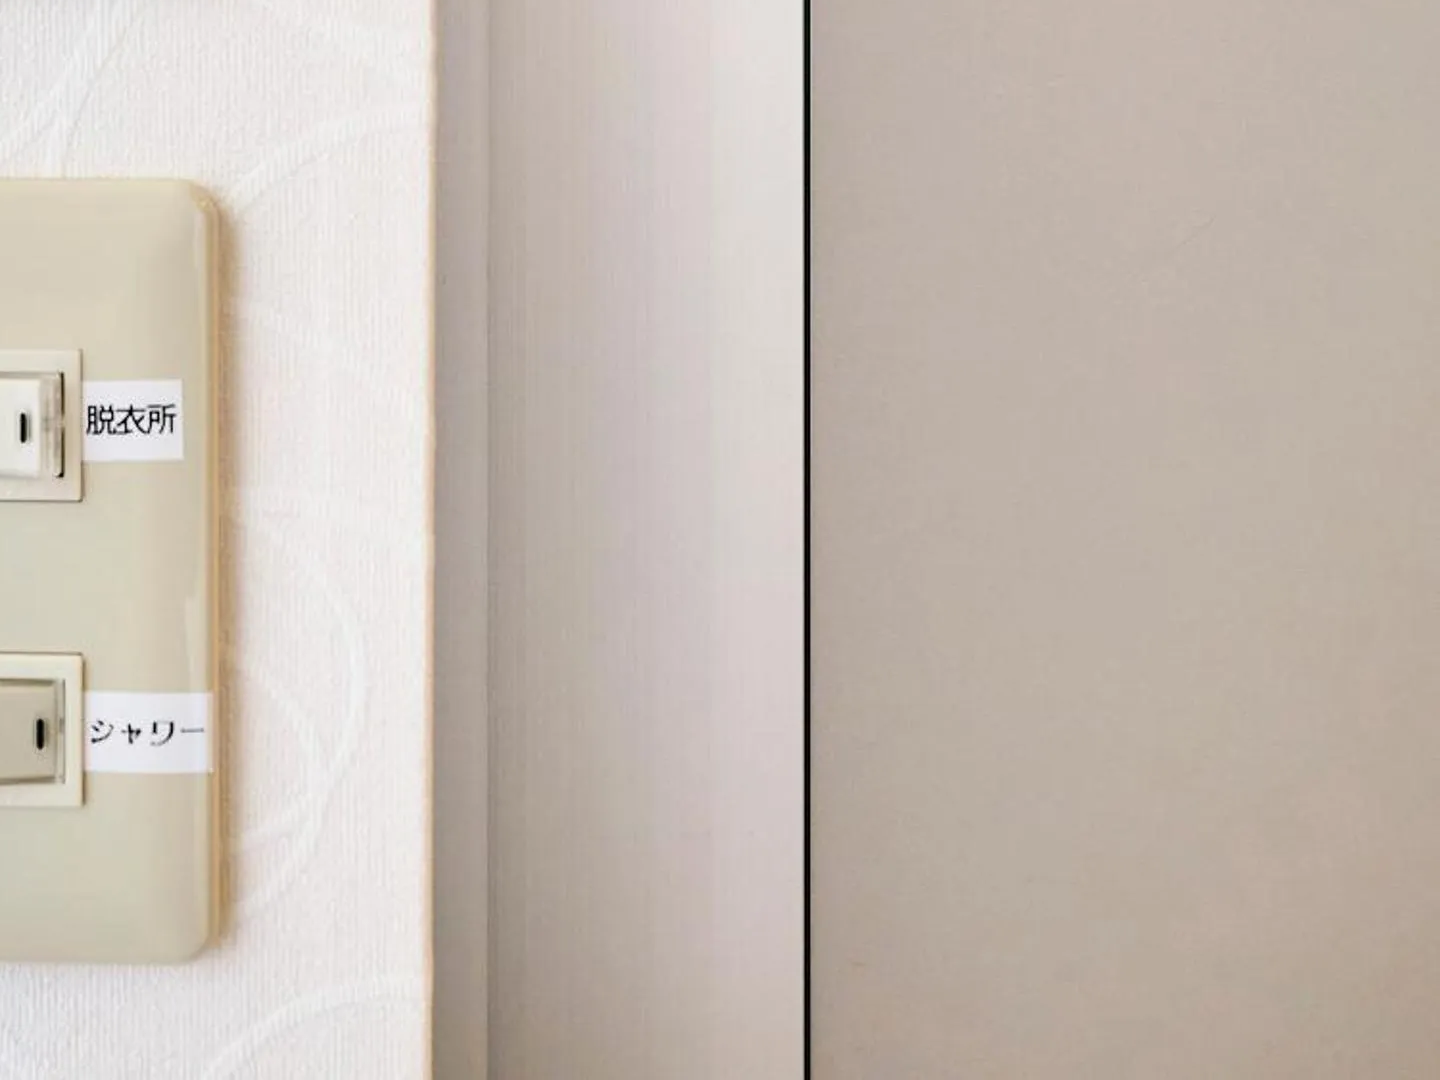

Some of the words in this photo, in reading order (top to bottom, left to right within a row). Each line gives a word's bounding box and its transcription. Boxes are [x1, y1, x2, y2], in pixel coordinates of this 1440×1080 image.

[86, 403, 177, 436] 脱衣所
[91, 720, 205, 746] シャワー
